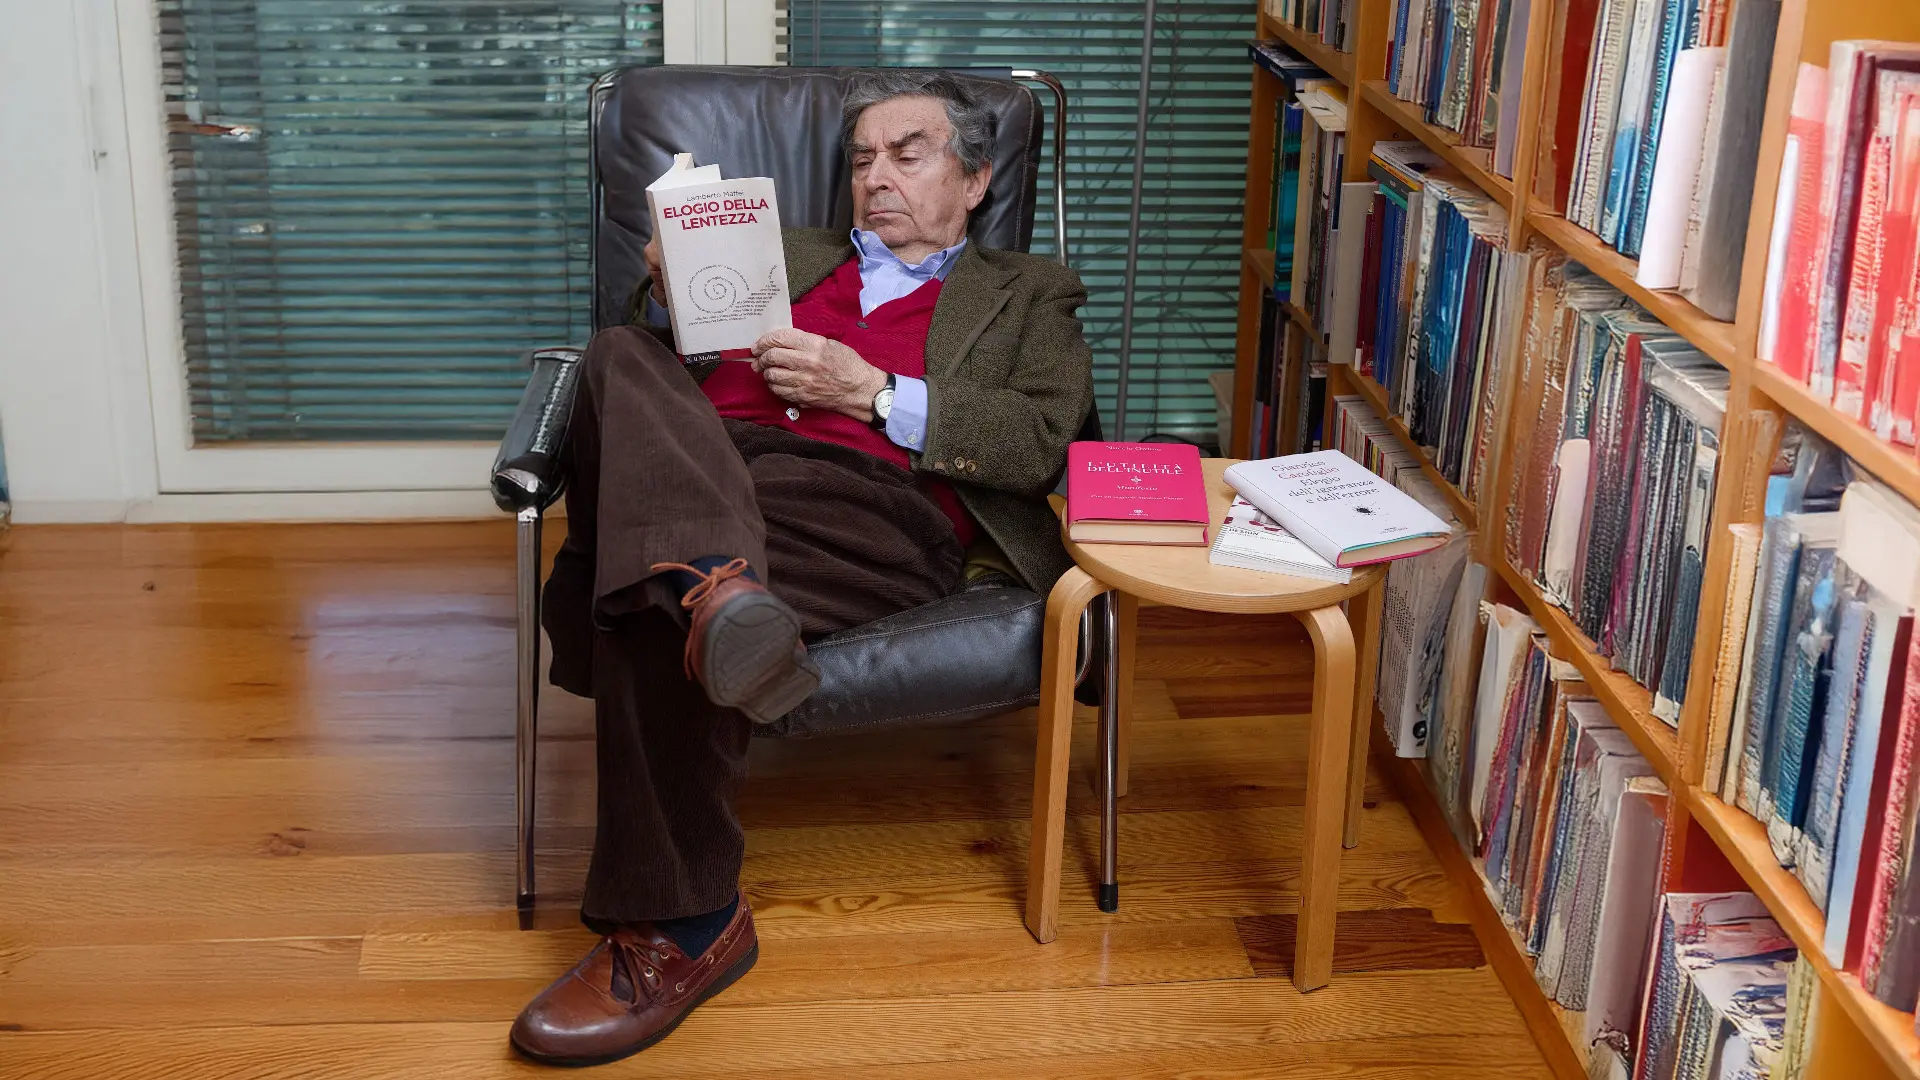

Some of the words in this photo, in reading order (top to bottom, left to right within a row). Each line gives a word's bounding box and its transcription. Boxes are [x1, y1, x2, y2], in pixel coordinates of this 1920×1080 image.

[663, 201, 720, 219] ELOGIO
[723, 198, 769, 211] DELLA
[681, 212, 758, 230] LENTEZZA
